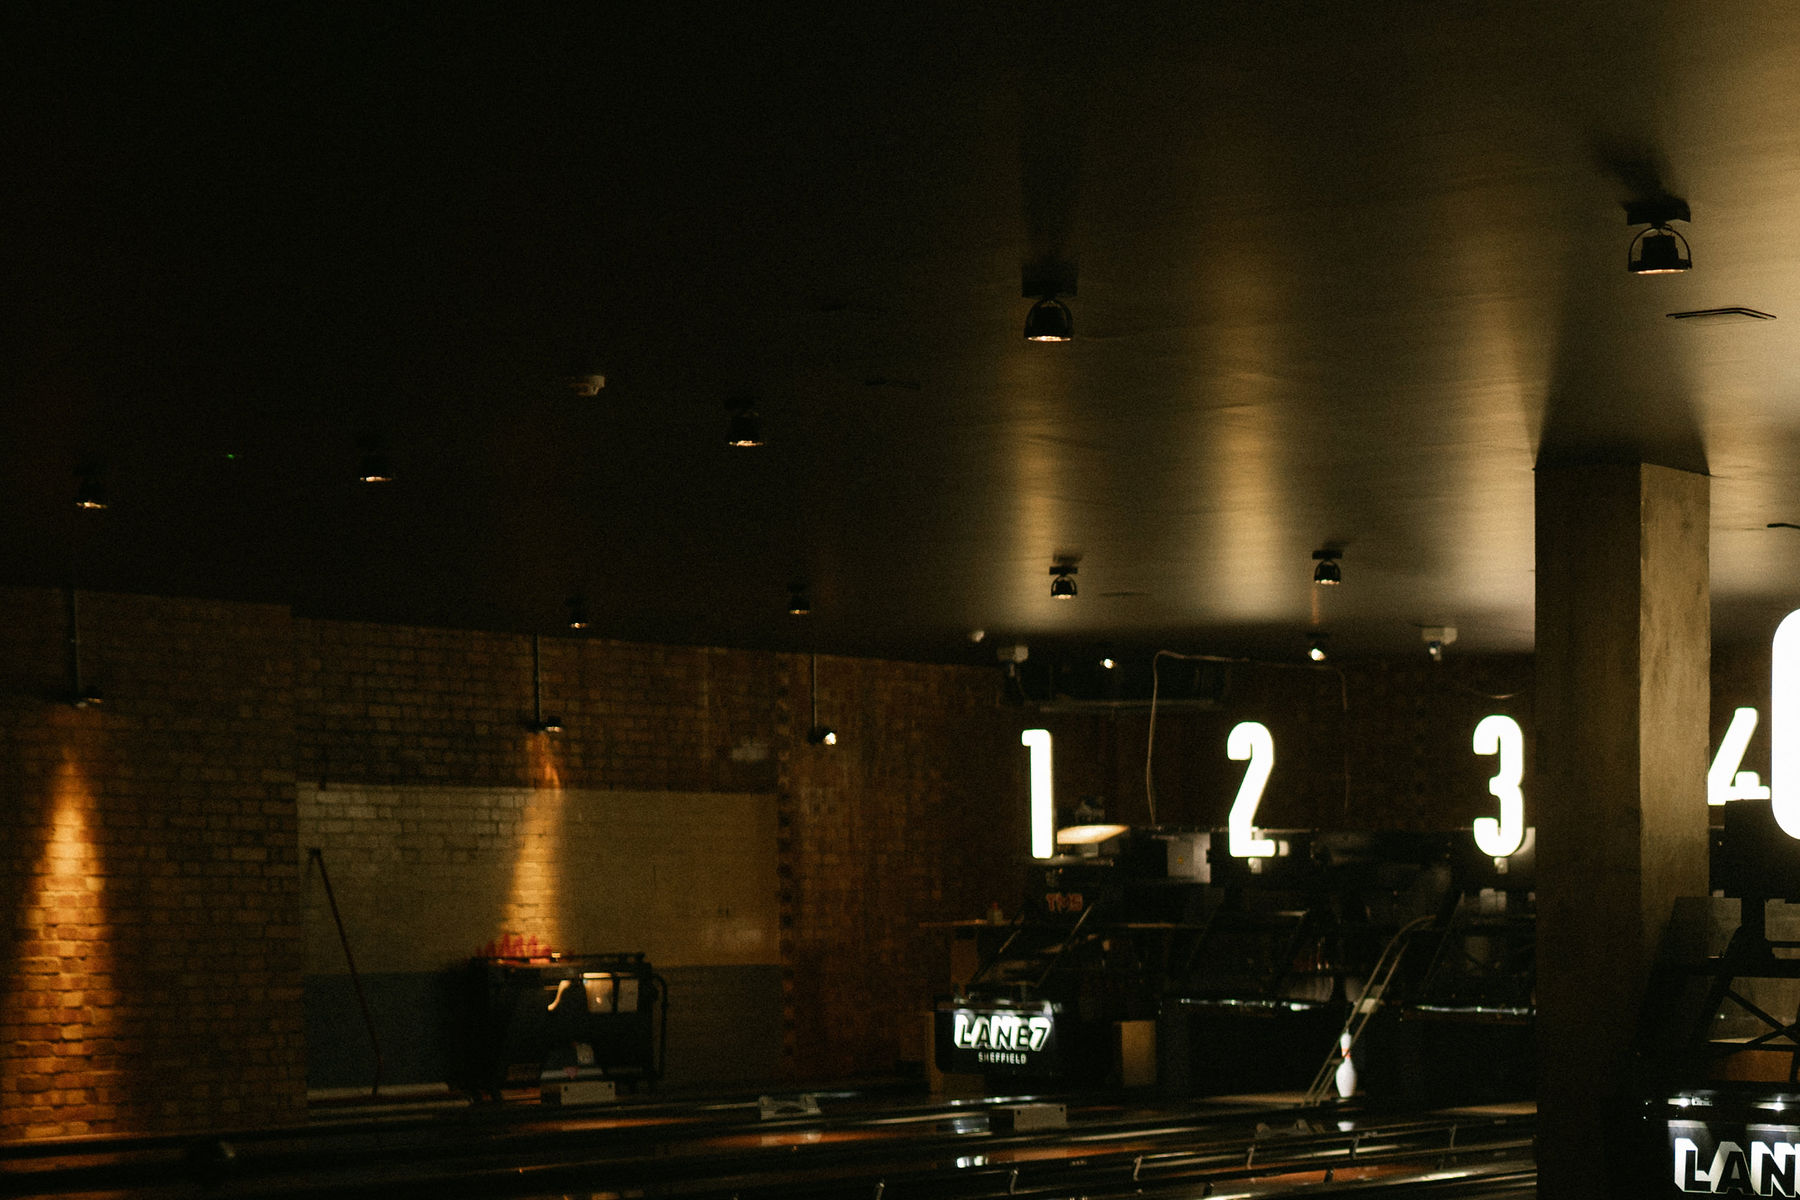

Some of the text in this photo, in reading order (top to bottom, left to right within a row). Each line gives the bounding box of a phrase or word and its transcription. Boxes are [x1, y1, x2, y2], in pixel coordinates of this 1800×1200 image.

[1021, 729, 1055, 859] 1
[1226, 721, 1276, 858] 2
[1472, 715, 1525, 857] 3
[1707, 707, 1771, 806] 4
[978, 1051, 1028, 1064] SHEFFIELD
